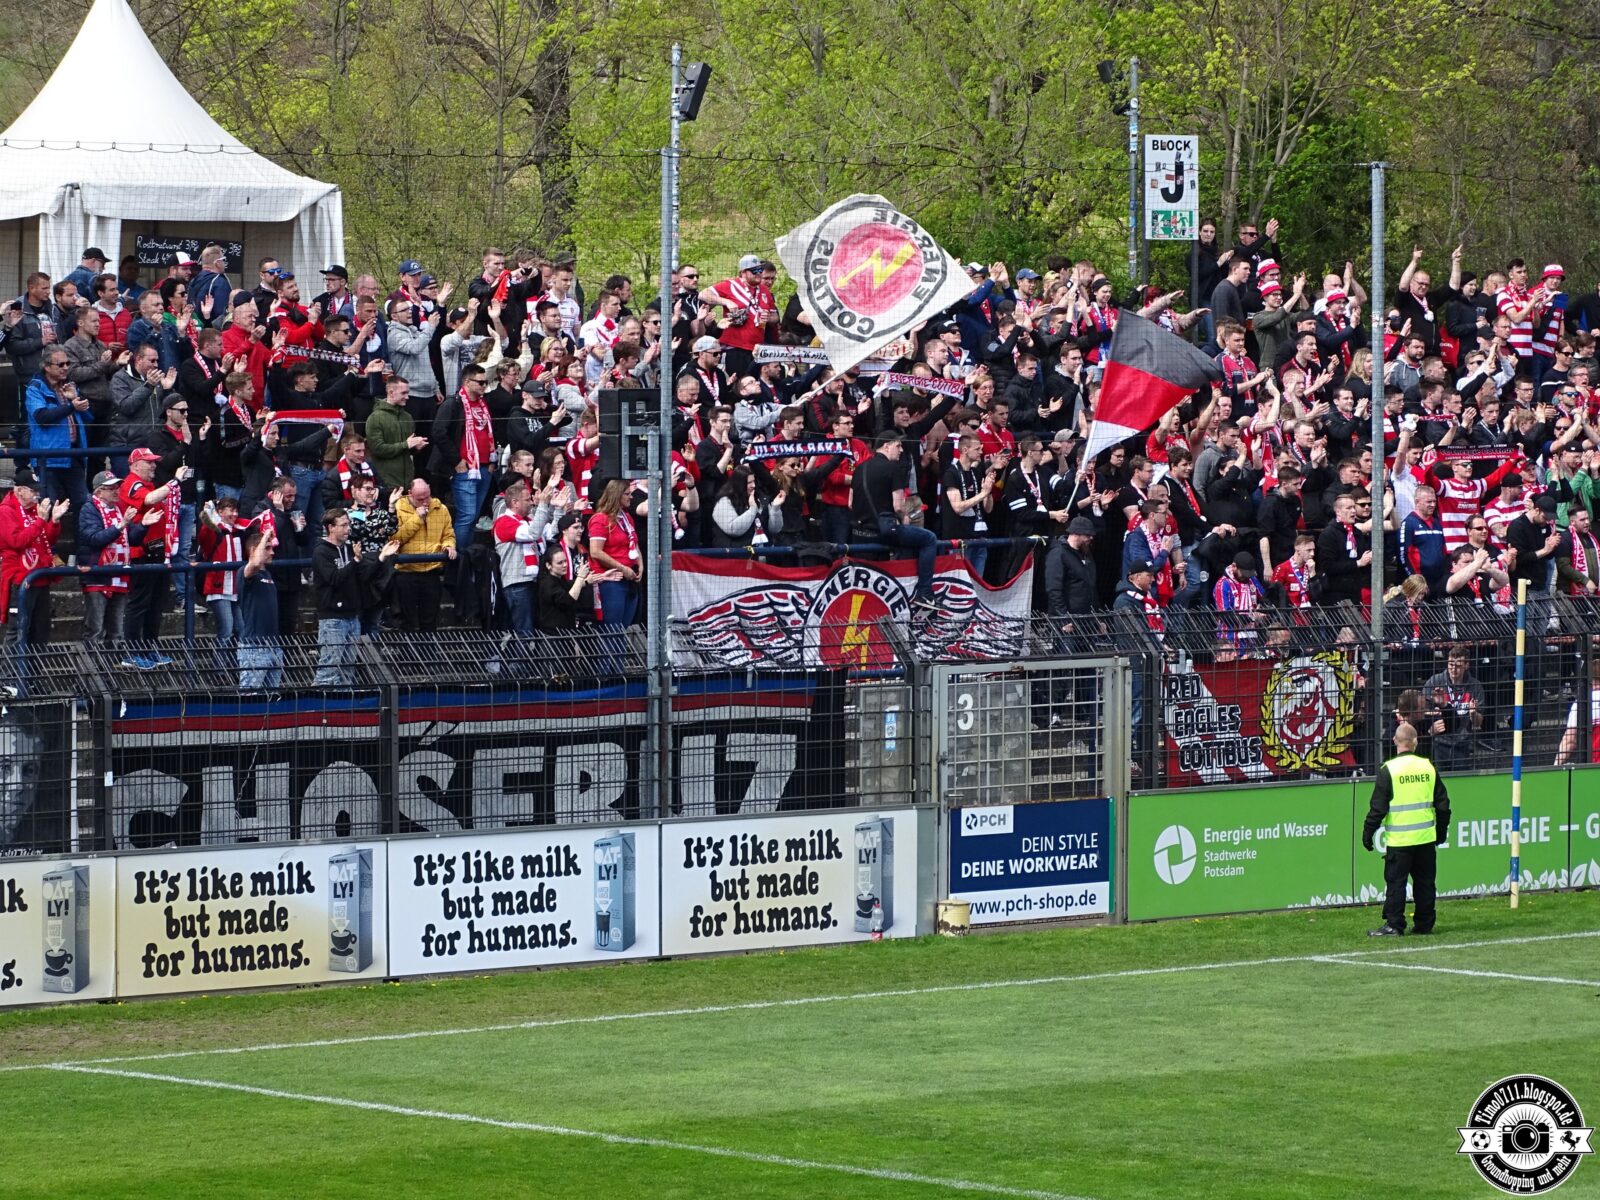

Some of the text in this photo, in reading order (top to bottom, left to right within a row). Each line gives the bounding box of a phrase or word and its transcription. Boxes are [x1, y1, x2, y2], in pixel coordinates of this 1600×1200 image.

[1152, 139, 1191, 151] BLOCK
[1160, 161, 1184, 203] J
[138, 252, 160, 264] Steak
[889, 373, 930, 388] ENERGIE
[754, 444, 803, 457] ULTIMA
[814, 566, 908, 620] ENERGIE
[1166, 674, 1202, 703] RED
[957, 693, 974, 731] 3
[1173, 705, 1242, 740] EAGLES
[1179, 737, 1262, 772] COTTBUS
[1399, 774, 1430, 784] ORDNER
[980, 814, 1006, 827] PCH
[1204, 822, 1328, 845] Energie und Wasser
[684, 829, 842, 868] It's like milk
[858, 848, 876, 864] LY!
[1022, 833, 1098, 853] DEIN STYLE
[1204, 848, 1257, 862] Stadtwerke
[414, 845, 581, 886] It's like milk
[598, 864, 618, 880] LY!
[961, 853, 1098, 878] DEINE WORKWEAR
[1204, 865, 1244, 878] Potsdam
[134, 861, 315, 904] It's like milk
[334, 882, 354, 898] LY!
[710, 866, 818, 901] but made
[48, 899, 69, 917] LY!
[442, 883, 556, 920] but made
[970, 890, 1096, 916] ww.pch-shop.de
[164, 900, 288, 939] but made
[690, 902, 837, 938] for humans.
[422, 920, 577, 957] for humans.
[142, 939, 310, 978] for humans.
